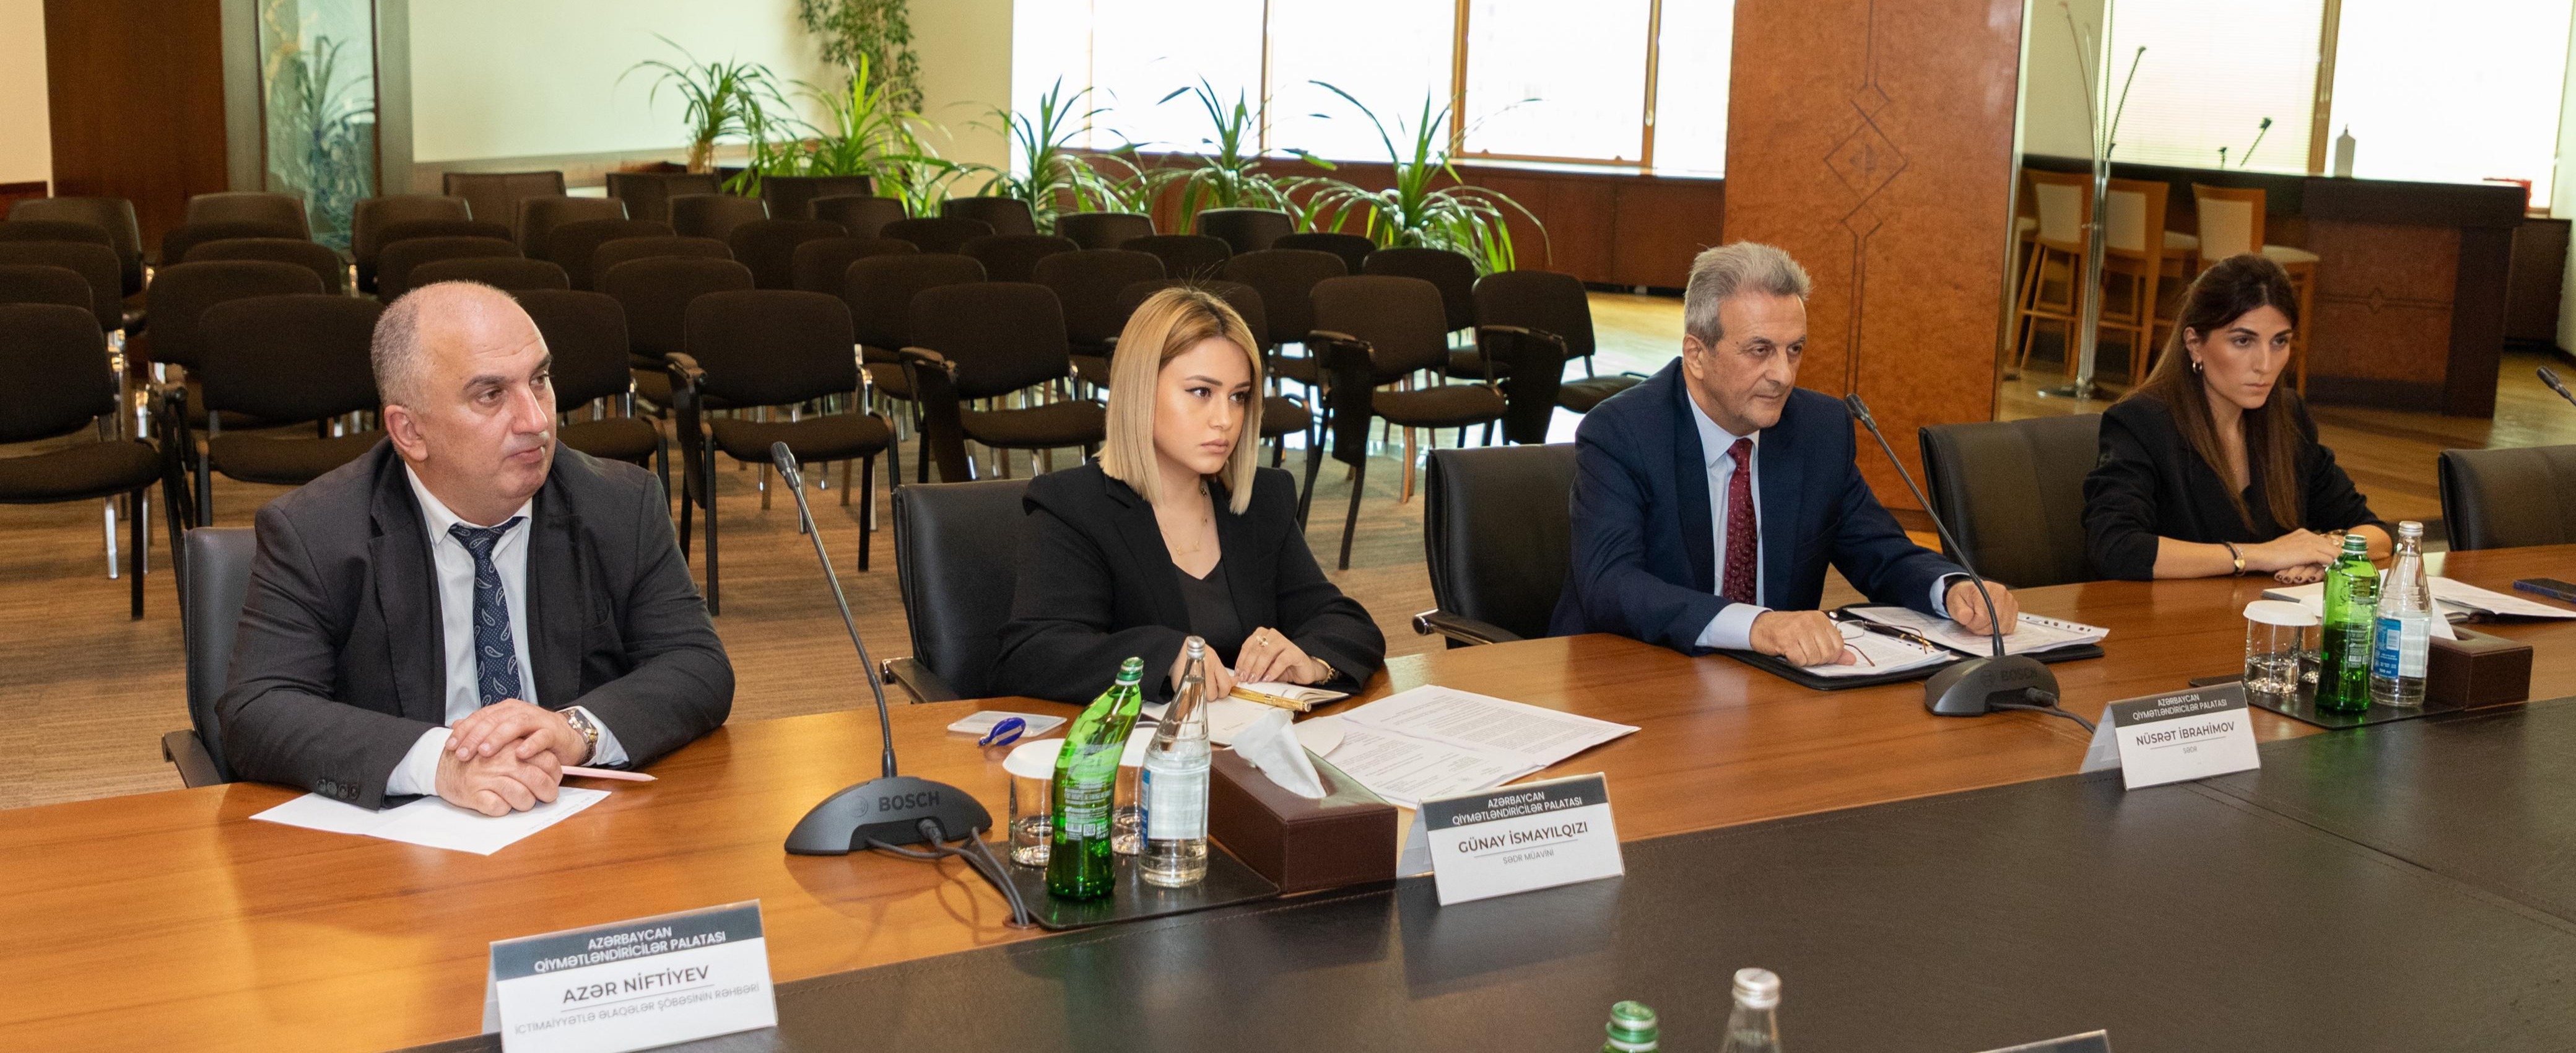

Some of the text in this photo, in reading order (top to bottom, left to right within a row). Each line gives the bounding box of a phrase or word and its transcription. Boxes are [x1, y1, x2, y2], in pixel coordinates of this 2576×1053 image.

[2133, 699, 2227, 720] QİYMƏTLƏNDİRİCİLƏR PALATASI
[2158, 694, 2200, 707] AZƏRBAYCAN
[2136, 721, 2234, 746] NÜSRƏT İBRAHİMOV
[2183, 746, 2198, 754] SƏDR
[878, 790, 940, 812] BOSCH
[1452, 797, 1583, 825] QİYMƏTLƏNDİRİCİLƏR PALATASI
[1487, 791, 1545, 809] AZƏRBAYCAN
[1458, 821, 1588, 853] GÜNAY İSMAYILQIZI
[1502, 849, 1554, 864] SƏDR MÜAVİNİ
[588, 926, 672, 950] AZƏRBAYCAN
[534, 931, 726, 972] QİYMƏTLƏNDİRİCİLƏR PALATASI
[562, 965, 710, 1003] AZƏR NİFTİYEV
[598, 1001, 655, 1020] ƏLAQƏLƏR
[715, 982, 760, 999] RƏHBƏRİ
